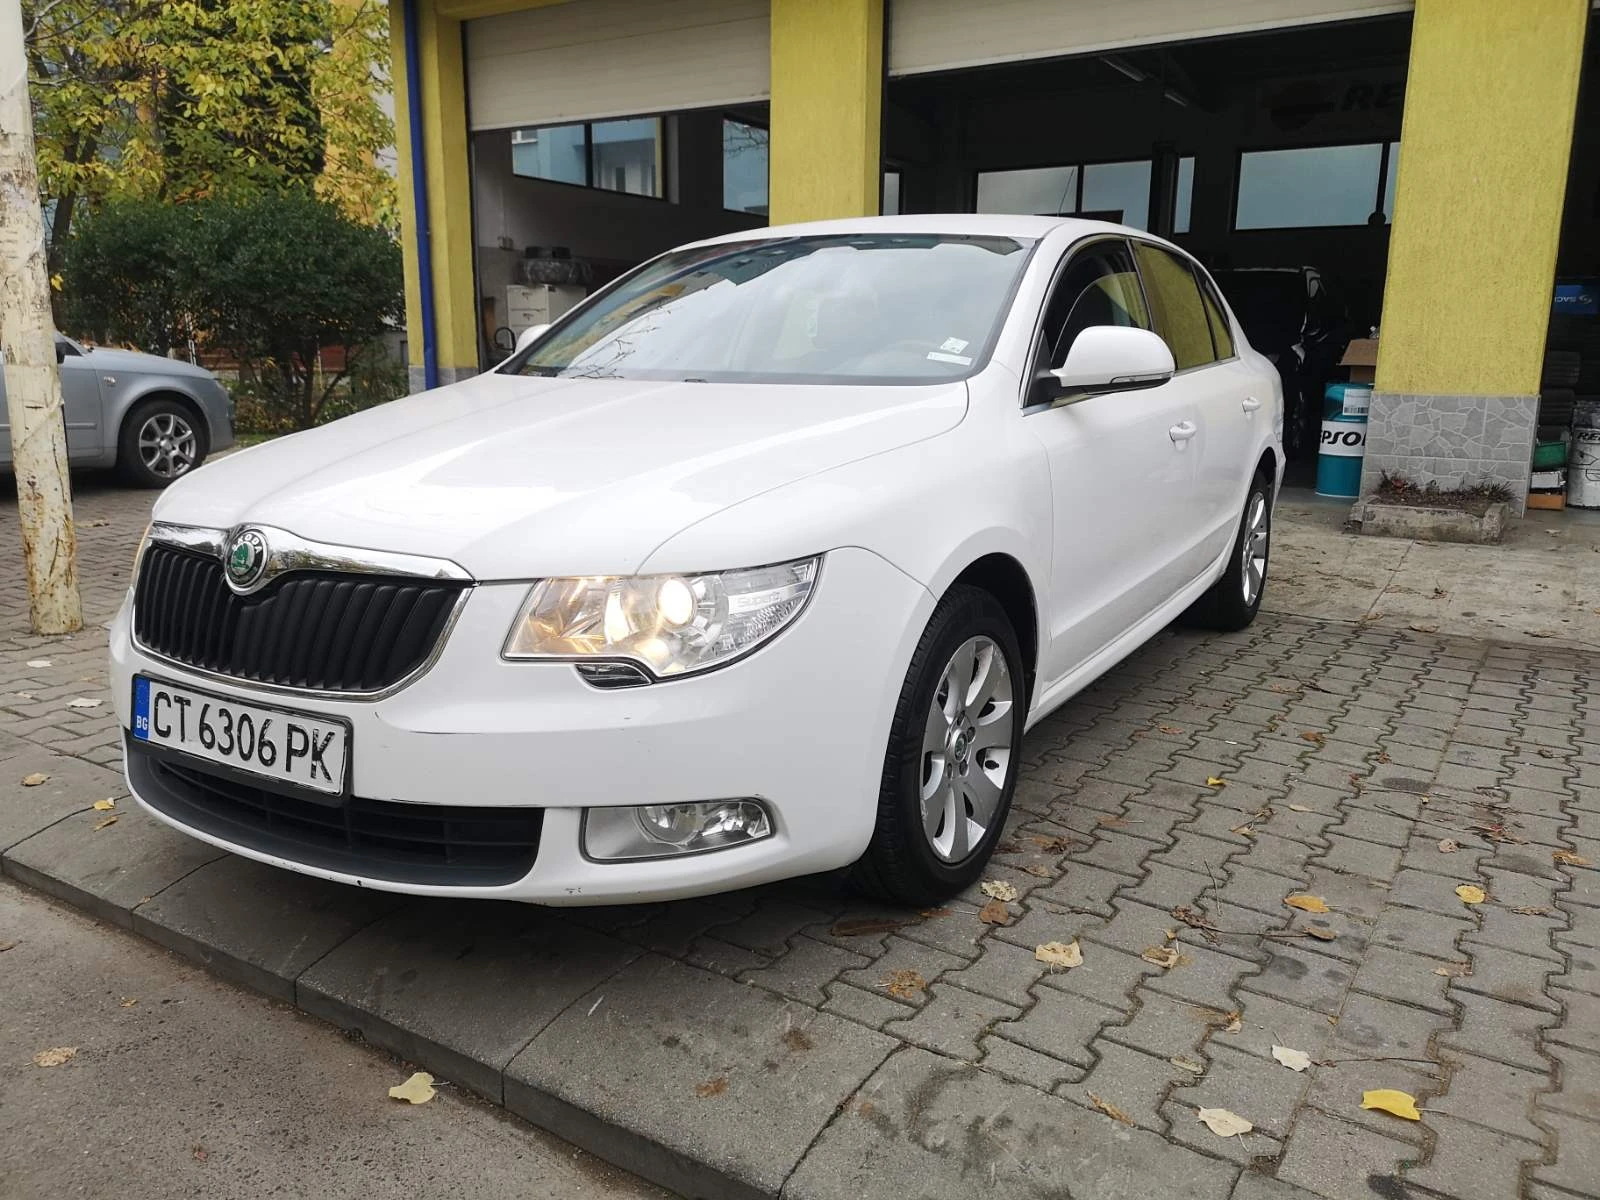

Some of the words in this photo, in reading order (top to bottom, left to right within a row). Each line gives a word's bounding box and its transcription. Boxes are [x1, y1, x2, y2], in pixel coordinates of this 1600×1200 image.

[1320, 430, 1366, 447] PSO
[136, 715, 148, 730] BG
[153, 691, 191, 742] CT
[199, 703, 277, 767] 6306
[285, 723, 336, 783] PK
